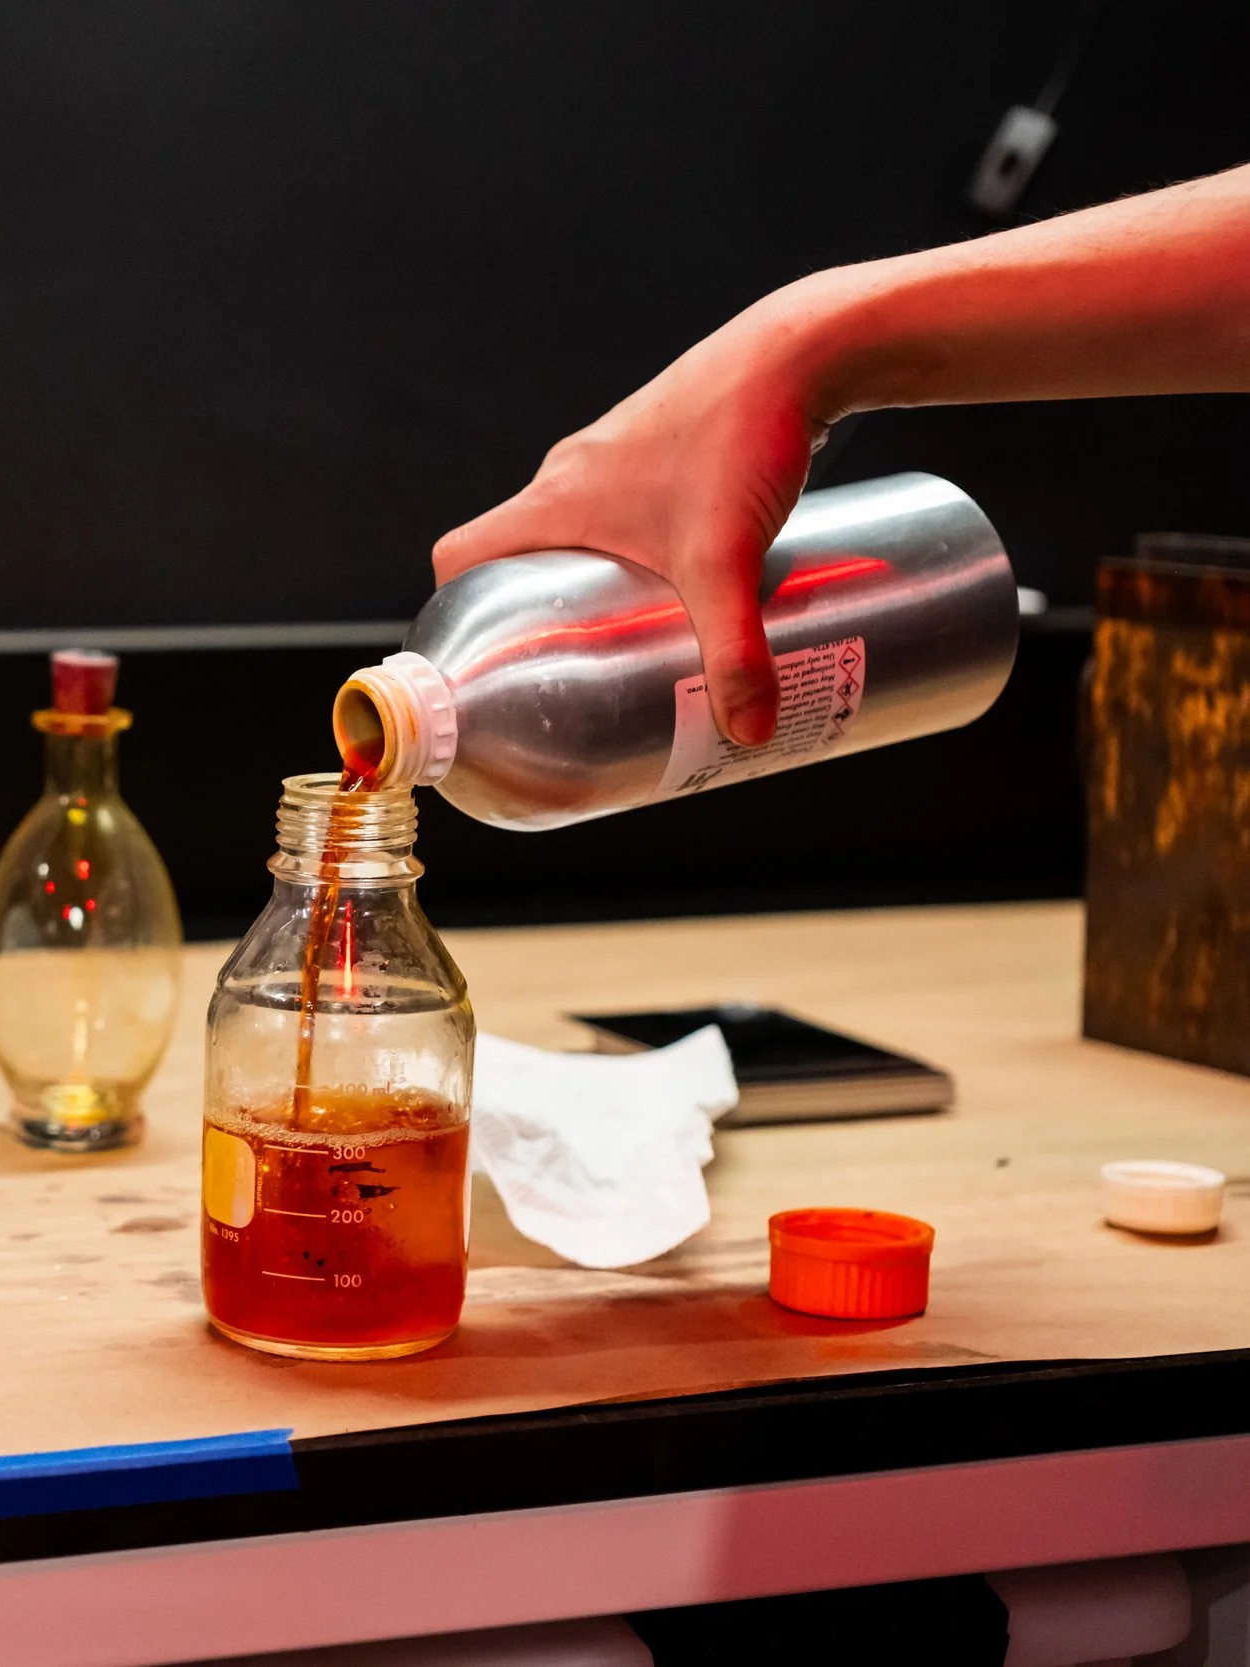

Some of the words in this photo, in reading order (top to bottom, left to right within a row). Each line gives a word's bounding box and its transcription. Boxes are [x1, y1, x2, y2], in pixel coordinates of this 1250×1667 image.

[807, 655, 821, 668] only
[822, 652, 835, 661] Use
[332, 1145, 366, 1161] 300
[330, 1210, 364, 1224] 200
[221, 1228, 239, 1243] 1395
[333, 1274, 362, 1288] 100
